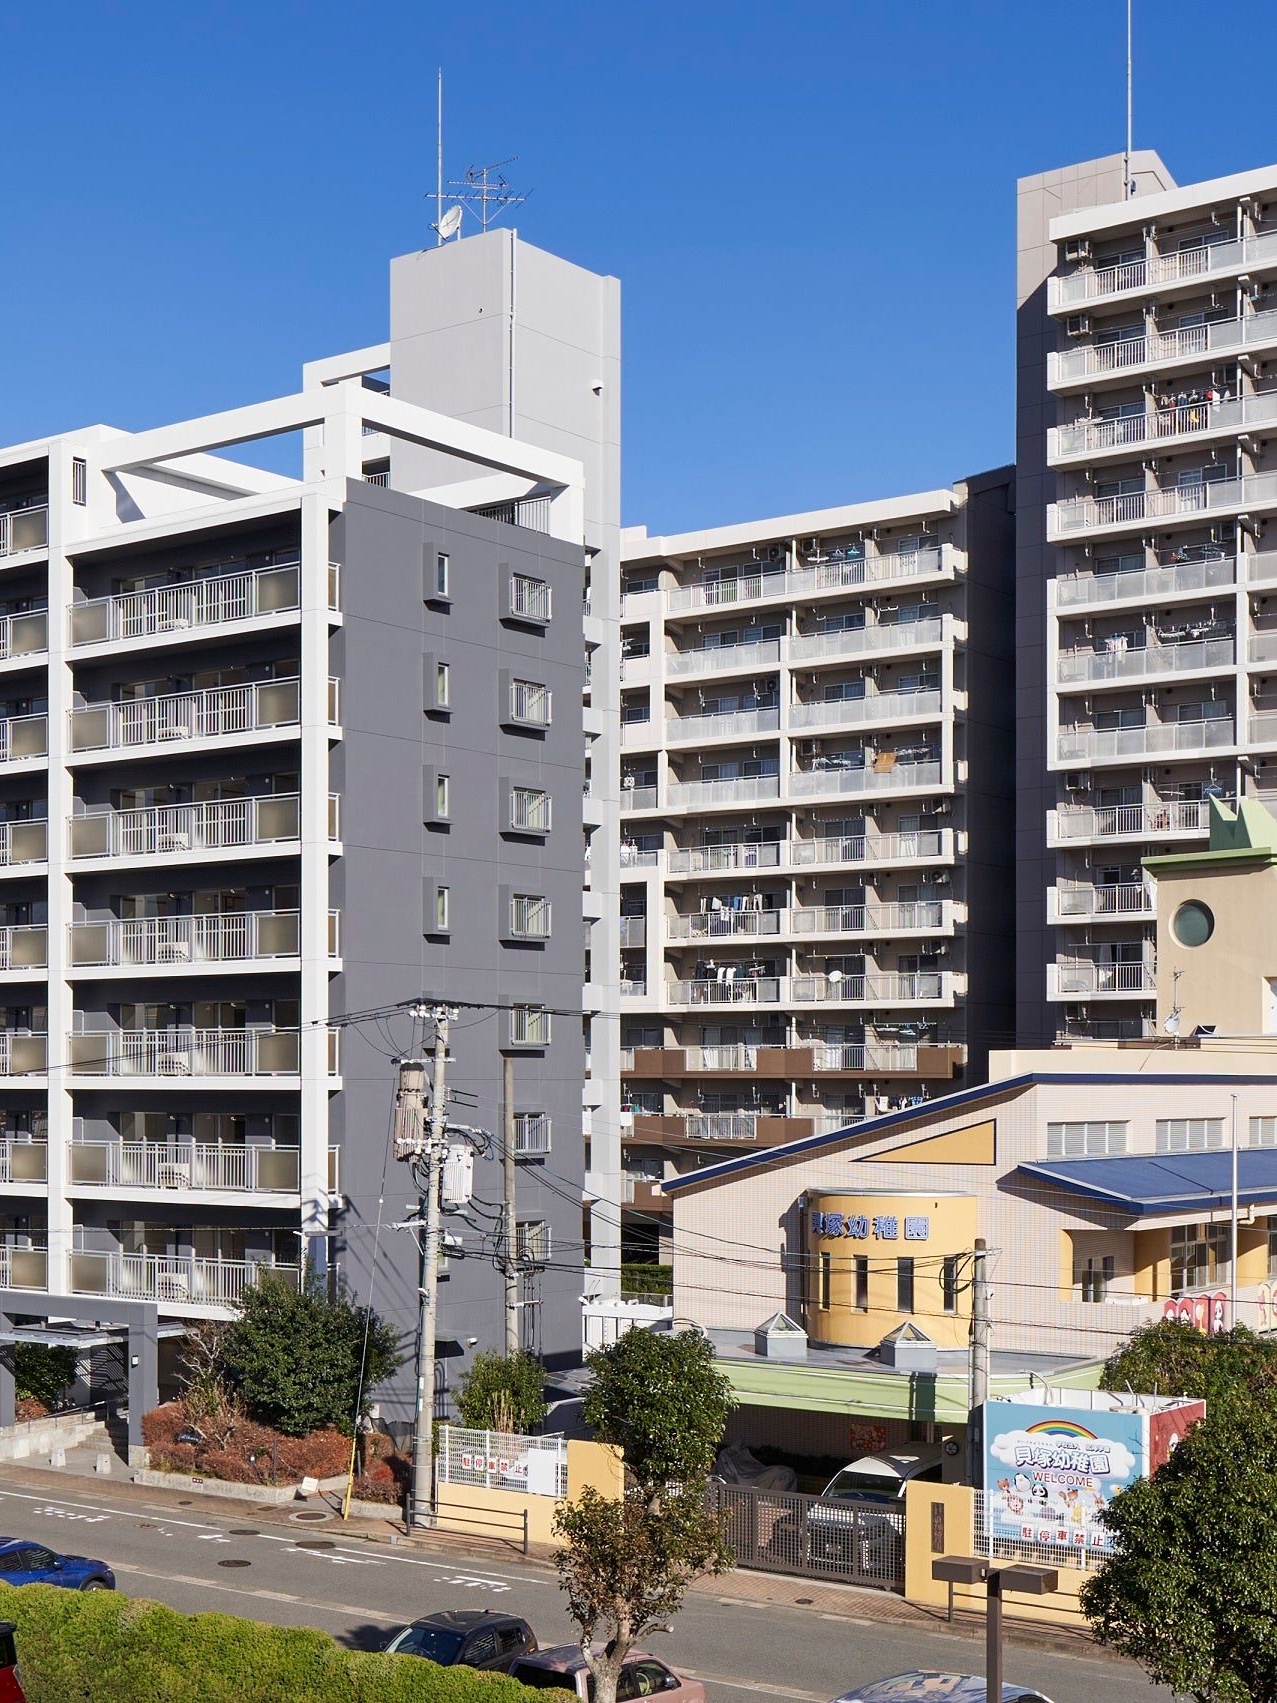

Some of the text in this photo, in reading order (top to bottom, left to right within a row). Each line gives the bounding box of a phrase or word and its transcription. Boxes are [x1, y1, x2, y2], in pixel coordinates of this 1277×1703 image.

[1015, 1446, 1111, 1474] 貝塚幼稚園
[1032, 1471, 1093, 1488] WELCOME
[1022, 1527, 1104, 1547] 駐停車禁止
